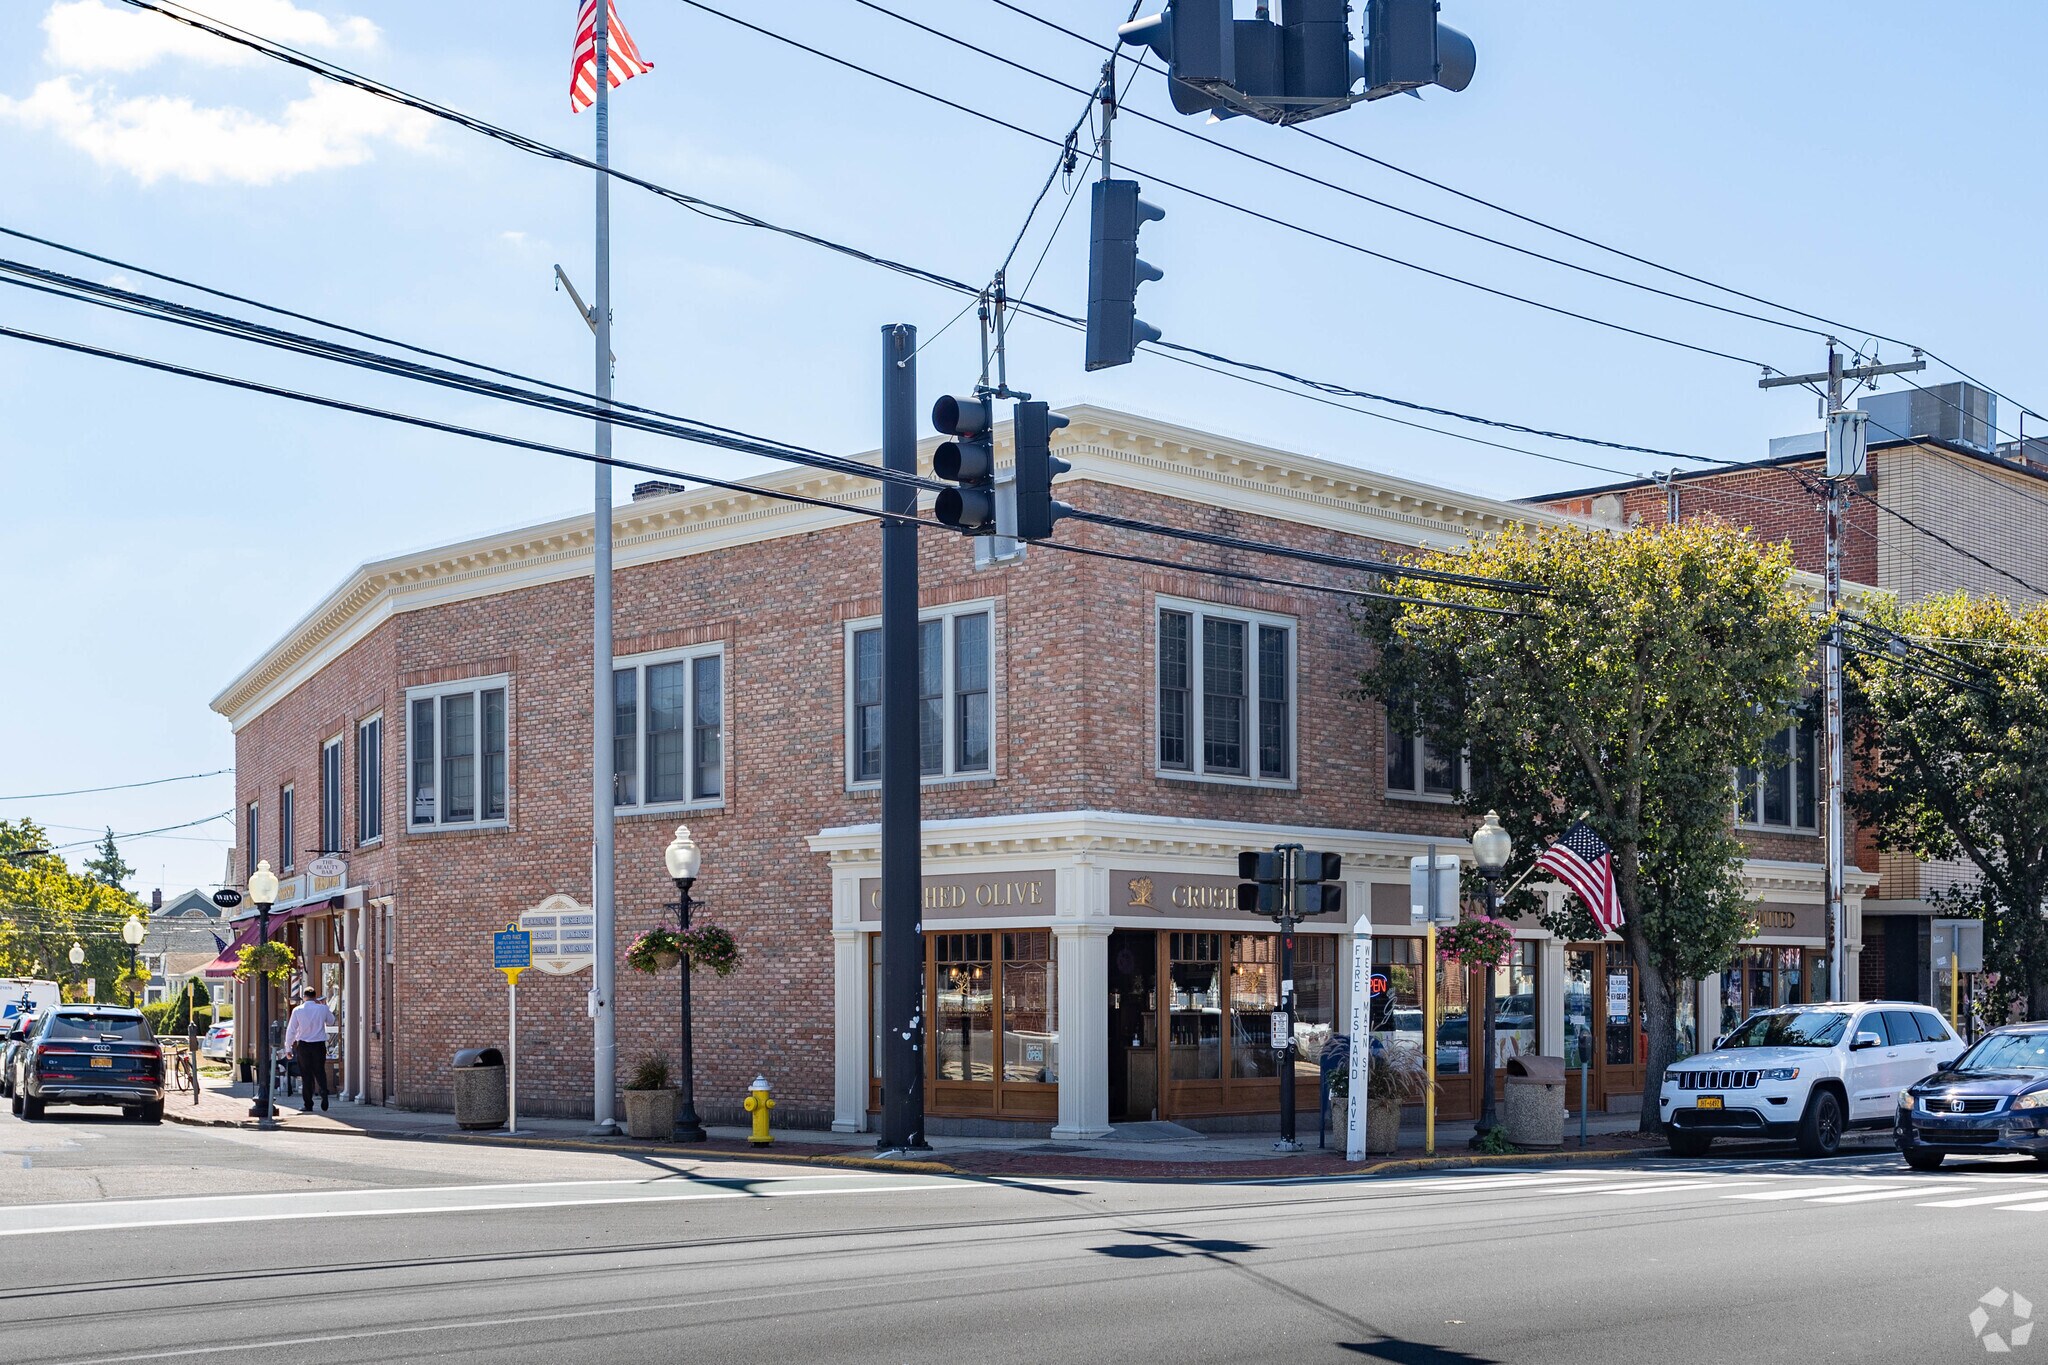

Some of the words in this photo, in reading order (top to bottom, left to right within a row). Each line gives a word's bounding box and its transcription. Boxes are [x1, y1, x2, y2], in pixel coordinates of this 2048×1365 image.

[871, 885, 966, 910] CHED
[975, 881, 1042, 906] OLIVE
[1171, 885, 1237, 910] CRUSH
[1370, 978, 1387, 993] PEN
[1027, 1051, 1043, 1060] OPEN
[1351, 1008, 1361, 1080] ISLAND
[1362, 1058, 1367, 1080] ST
